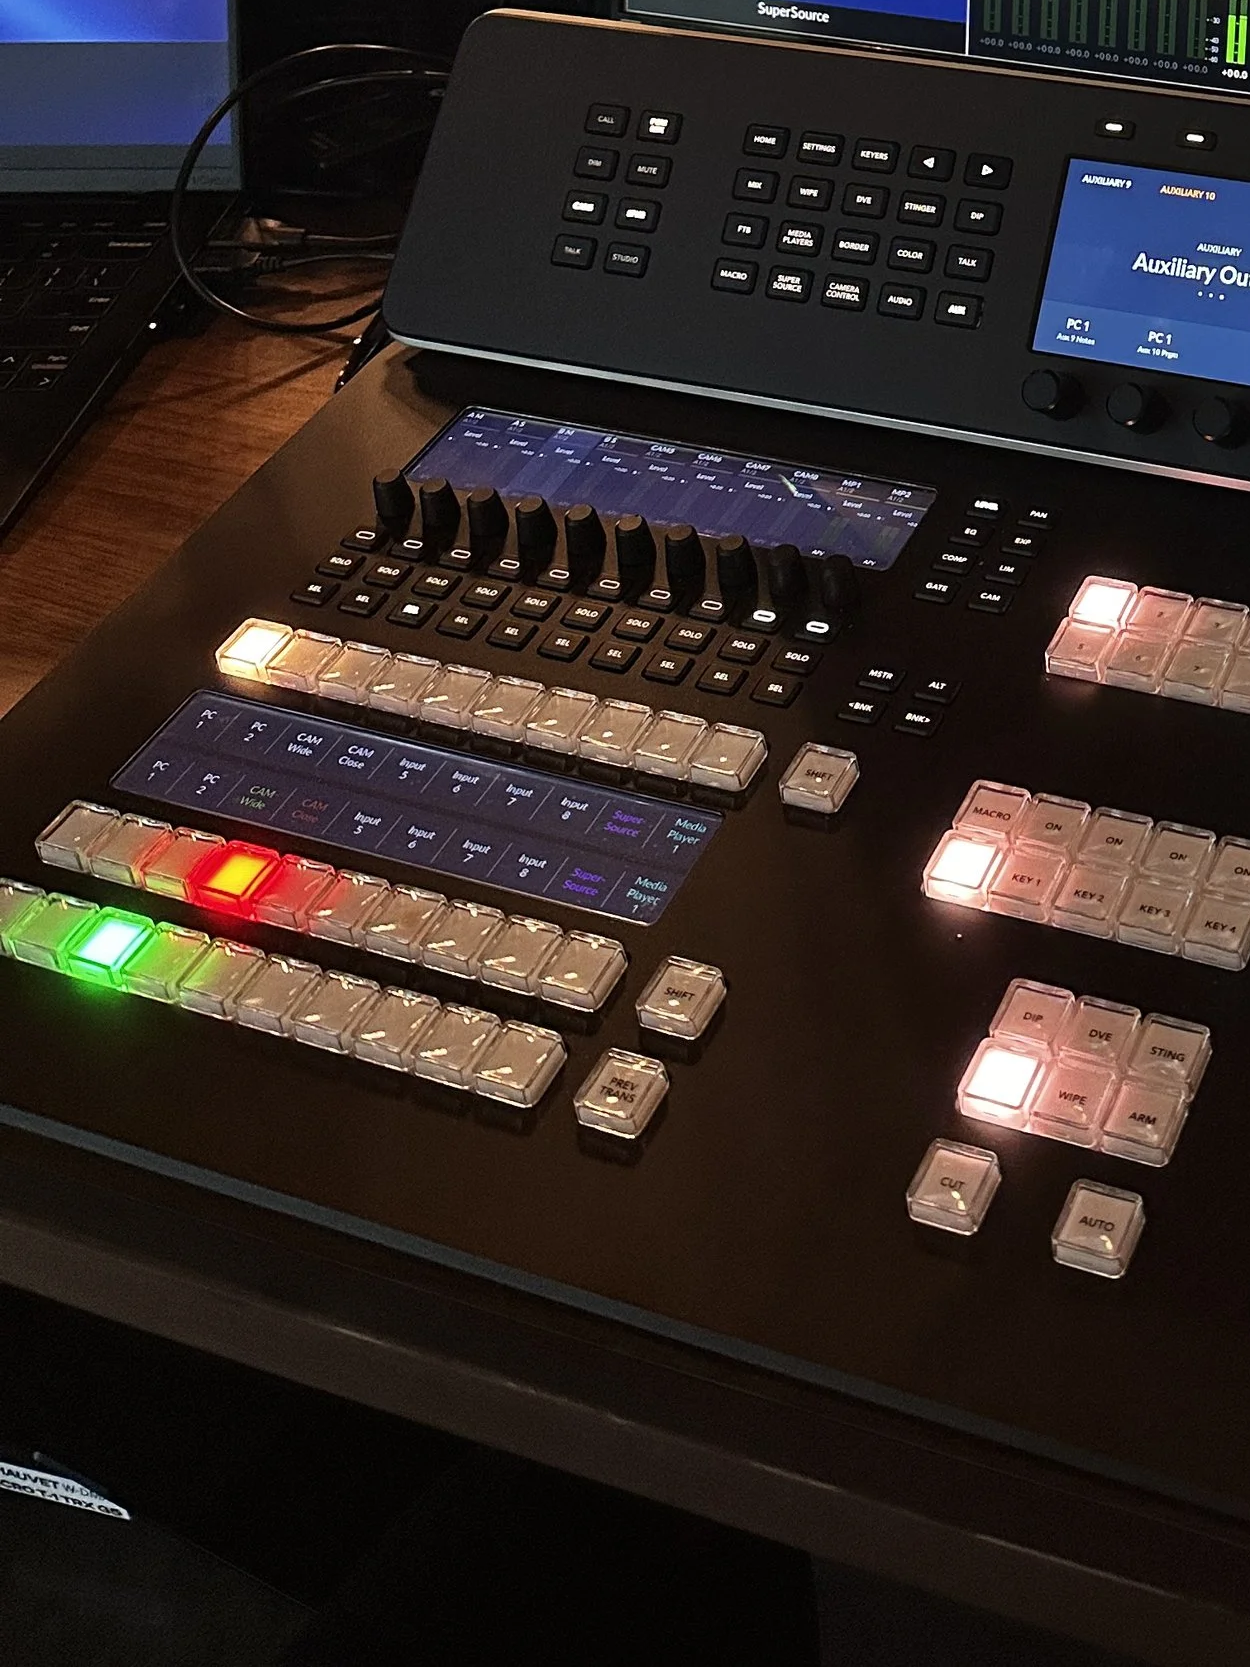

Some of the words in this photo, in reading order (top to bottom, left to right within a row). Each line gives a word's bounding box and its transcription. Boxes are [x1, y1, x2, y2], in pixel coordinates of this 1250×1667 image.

[758, 1, 830, 23] SuperSource
[754, 136, 776, 145] HOME
[803, 142, 836, 153] SETTINGS
[860, 150, 888, 160] KEYERS
[1081, 174, 1124, 189] AUXILIARY
[1125, 180, 1132, 189] 9
[800, 188, 818, 198] WIPE
[1160, 185, 1204, 199] AUXILIARY
[1205, 191, 1216, 201] 10
[856, 196, 872, 205] DVE
[904, 202, 936, 214] STINGER
[971, 211, 984, 220] DIP
[738, 225, 751, 234] FTB
[788, 229, 811, 239] MEDIA
[782, 236, 813, 247] PLAYERS
[839, 241, 869, 252] BORDER
[897, 250, 923, 260] COLOR
[1197, 243, 1242, 257] AUXILIARY
[958, 257, 976, 267] TALK
[720, 270, 747, 280] MACRO
[1132, 252, 1216, 286] Auxiliary
[778, 275, 800, 284] SUPER
[772, 282, 802, 292] SOURCE
[829, 283, 860, 294] CAMERA
[826, 290, 859, 302] CONTROL
[888, 295, 912, 306] AUDIO
[1066, 318, 1083, 332] PC
[1084, 320, 1090, 332] 1
[1147, 331, 1164, 345] PC
[1165, 333, 1172, 345] 1
[1030, 510, 1048, 519] PAN
[1014, 537, 1032, 546] EXP
[941, 553, 968, 565] COMP
[926, 582, 948, 593] GATE
[980, 592, 1001, 602] CAM
[869, 669, 894, 681] MSTR
[928, 681, 946, 690] ALT
[297, 733, 323, 746] CAM
[288, 742, 313, 756] Wide
[348, 746, 375, 758] CAM
[338, 756, 365, 769] Close
[400, 757, 427, 772] Input
[612, 810, 646, 825] Super-
[972, 806, 1011, 822] MACRO
[603, 821, 641, 837] Source
[675, 818, 707, 833] Media
[667, 829, 701, 846] Player
[1012, 874, 1032, 885] KEY
[1074, 889, 1095, 901] KEY
[1140, 904, 1160, 916] KEY
[1205, 920, 1227, 932] KEY
[664, 987, 695, 1001] SHIFT
[1023, 1011, 1044, 1023] DIP
[1089, 1029, 1112, 1042] DVE
[1150, 1046, 1186, 1062] STING
[610, 1077, 638, 1091] PREV
[600, 1086, 636, 1103] TRANS
[1058, 1090, 1087, 1105] WIPE
[1129, 1112, 1157, 1125] ARM
[940, 1177, 966, 1190] CUT
[1079, 1216, 1115, 1232] AUTO
